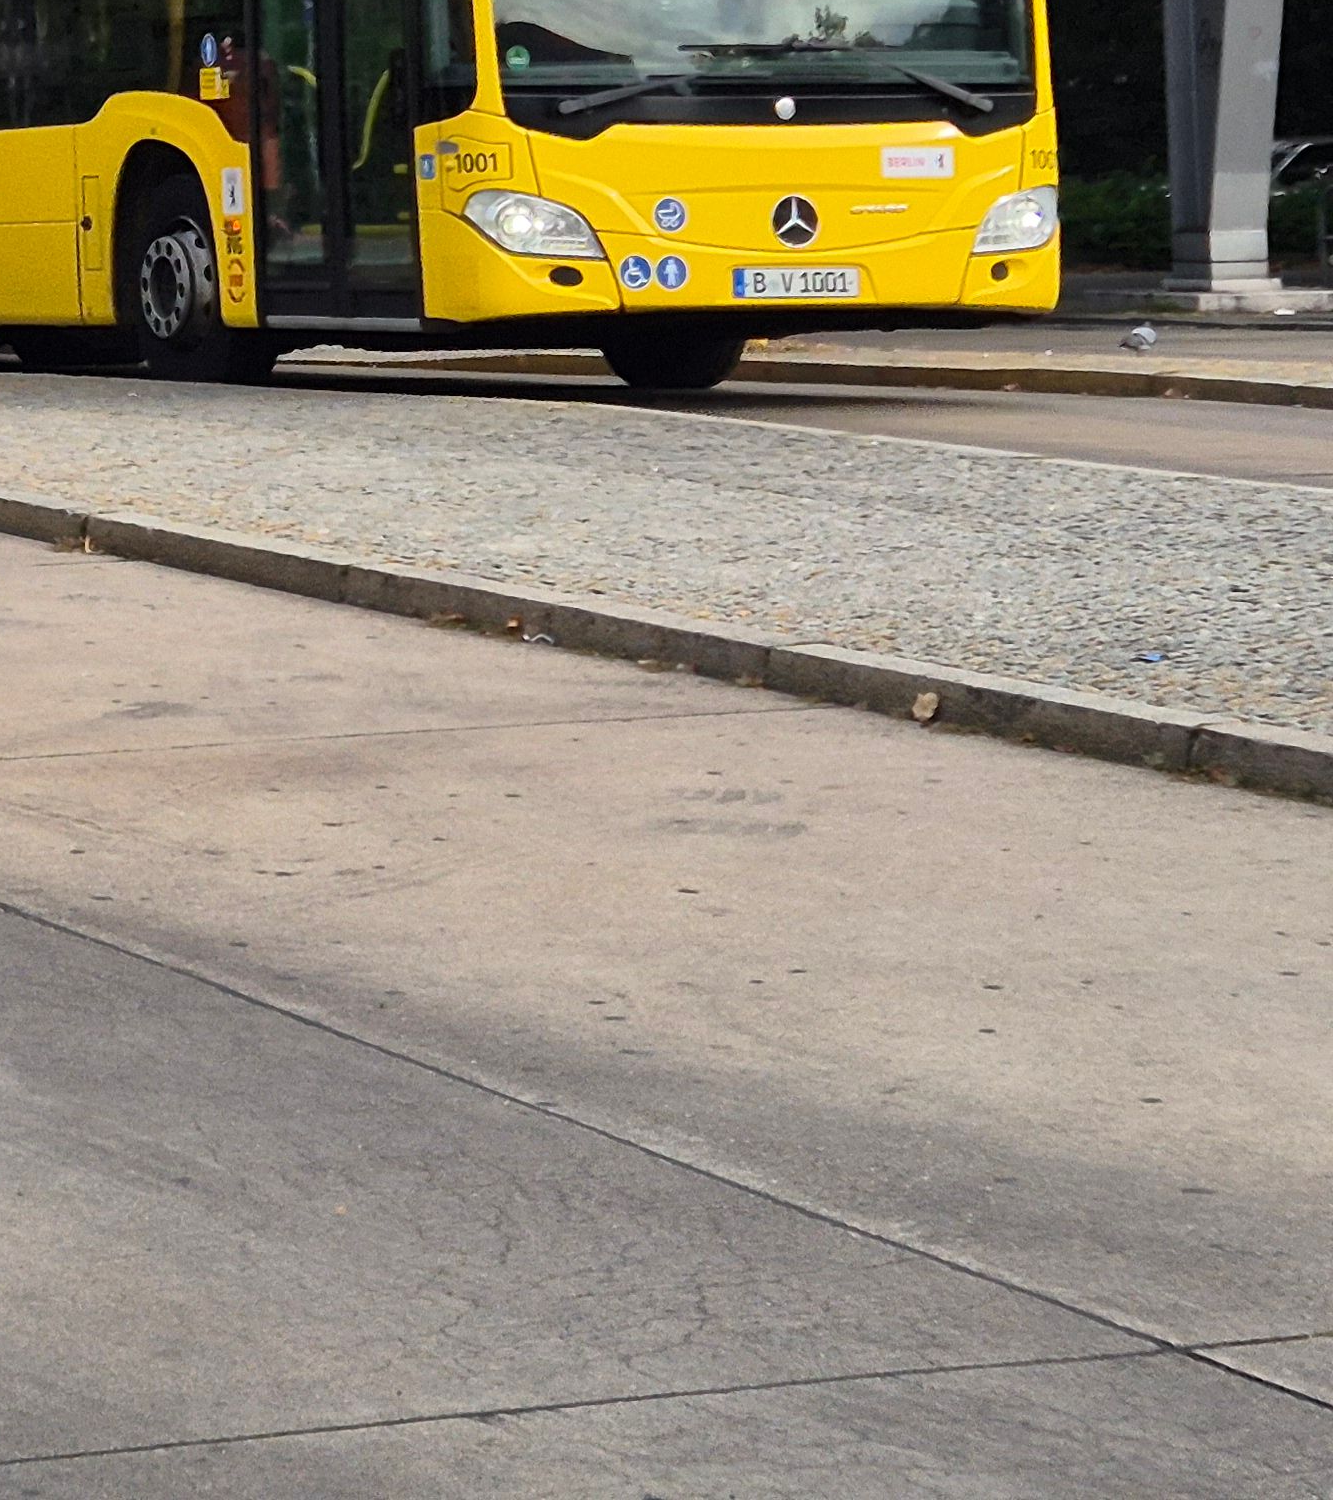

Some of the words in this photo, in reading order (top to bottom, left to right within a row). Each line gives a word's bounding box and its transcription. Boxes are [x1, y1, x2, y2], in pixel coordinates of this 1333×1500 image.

[454, 152, 499, 174] 1001
[1030, 149, 1057, 170] 100
[752, 272, 767, 293] B
[781, 272, 793, 293] V
[799, 271, 849, 293] 1001
